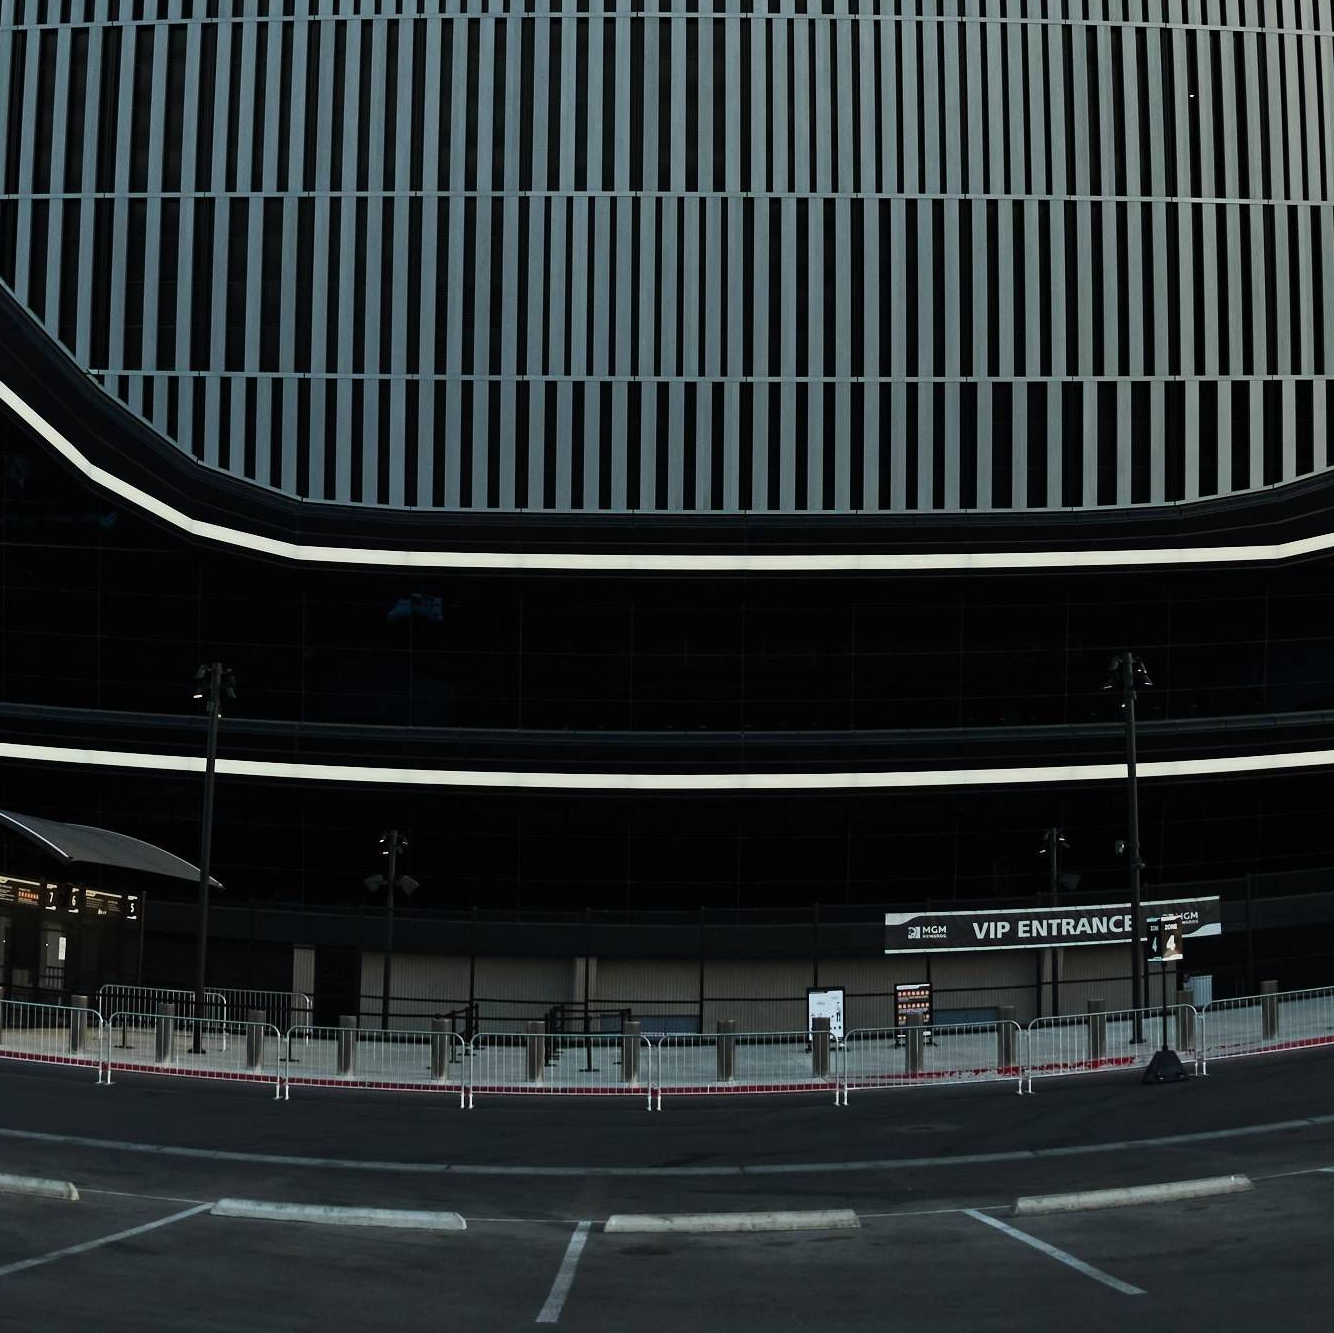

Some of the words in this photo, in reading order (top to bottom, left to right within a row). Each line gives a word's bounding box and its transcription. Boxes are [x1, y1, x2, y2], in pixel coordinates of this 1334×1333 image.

[922, 925, 947, 934] MGM
[972, 921, 1011, 940] VIP
[1017, 914, 1132, 938] ENTRANCE
[1166, 934, 1176, 951] 4
